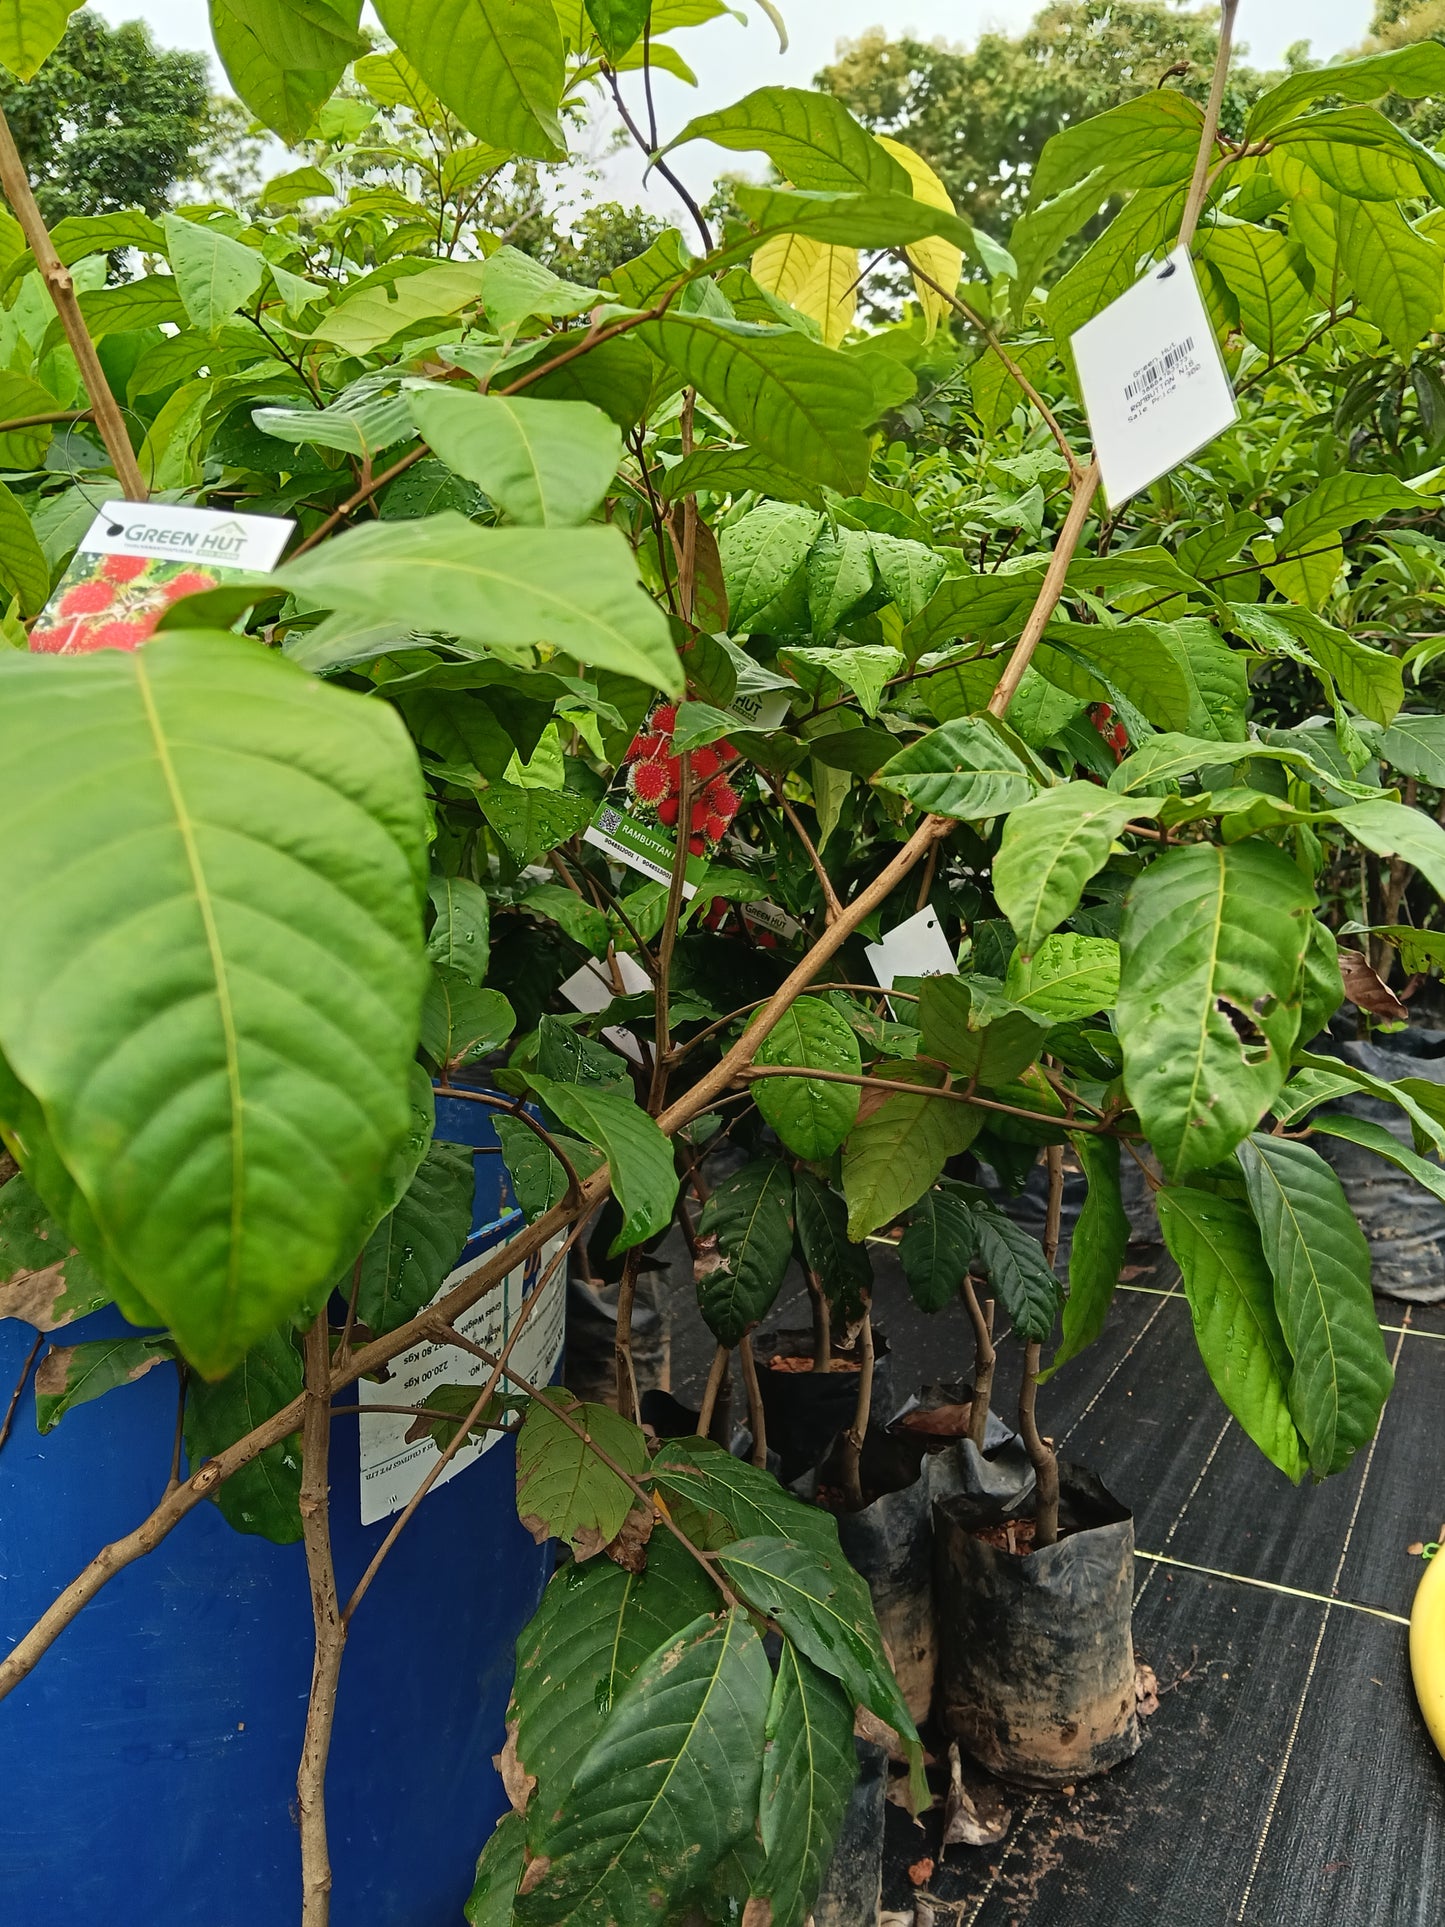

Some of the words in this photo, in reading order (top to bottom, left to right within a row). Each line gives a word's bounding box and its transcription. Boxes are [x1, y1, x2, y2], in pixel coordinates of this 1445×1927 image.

[1132, 356, 1159, 378] Green
[1160, 341, 1177, 356] Hut
[1128, 406, 1148, 423] Sale
[1151, 383, 1177, 406] Price
[1130, 375, 1175, 412] RAMBUTTAN
[124, 523, 200, 547] GREEN
[200, 534, 248, 553] HUT
[735, 696, 763, 716] HUT
[621, 824, 673, 858] RAMBUTTAN
[745, 904, 771, 922] GREEN
[770, 916, 787, 929] HUT
[485, 1301, 502, 1319] Gross
[460, 1313, 485, 1335] Weight
[403, 1352, 420, 1366] Kgs
[403, 1376, 420, 1391] Kgs
[421, 1360, 449, 1383] 220.00
